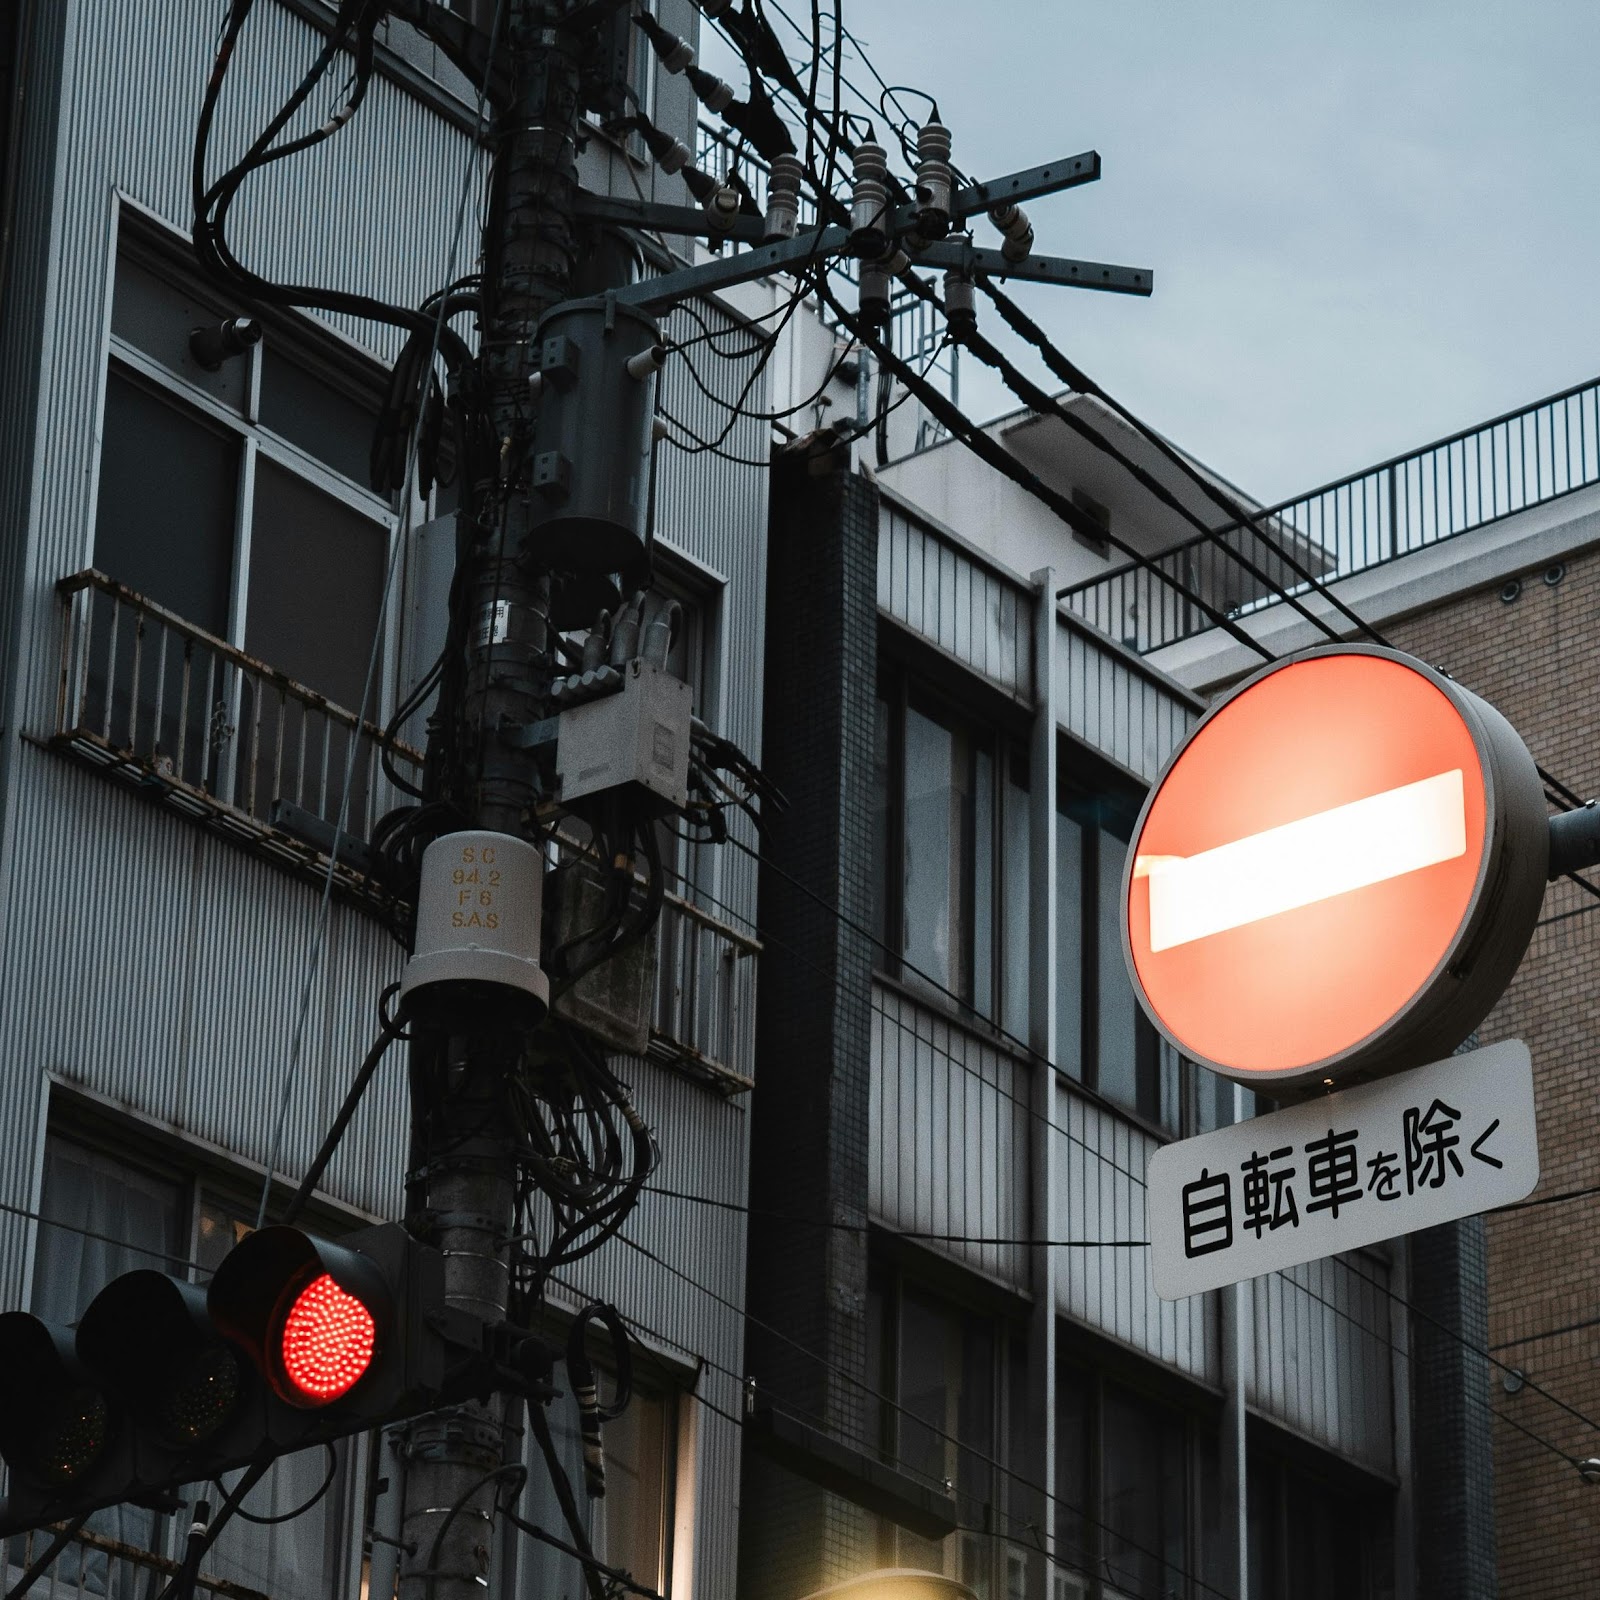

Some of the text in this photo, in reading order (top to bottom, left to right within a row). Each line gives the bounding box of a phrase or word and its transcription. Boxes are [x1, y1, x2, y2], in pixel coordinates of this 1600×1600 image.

[1181, 1098, 1503, 1259] 自転車を除く
